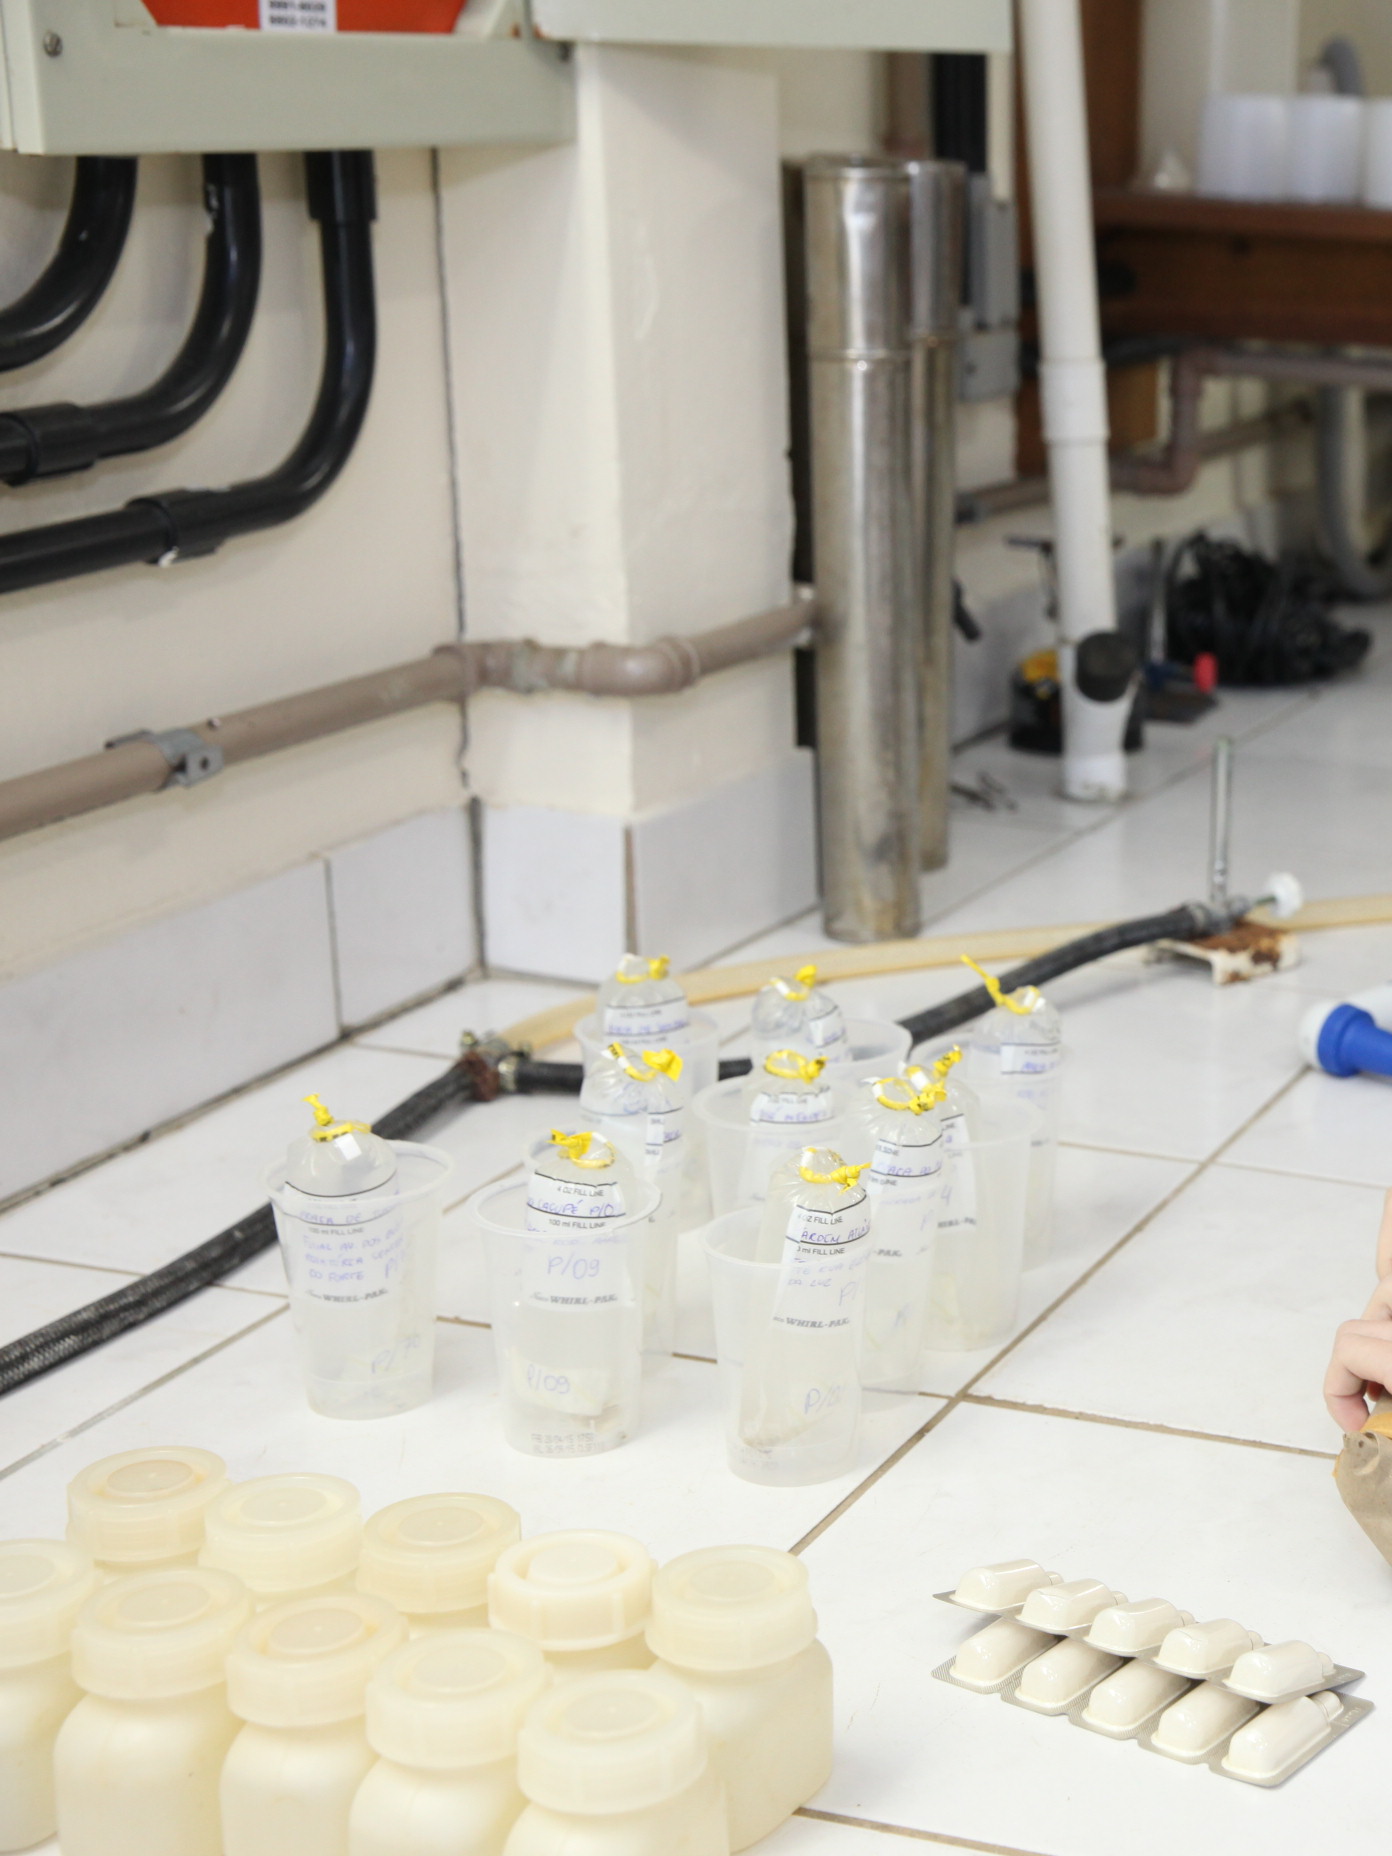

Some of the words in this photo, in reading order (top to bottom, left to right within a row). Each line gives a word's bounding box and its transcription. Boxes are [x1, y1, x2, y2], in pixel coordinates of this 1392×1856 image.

[574, 1188, 588, 1197] FILL
[572, 1221, 588, 1229] FILL
[814, 1216, 829, 1225] FILL
[830, 1216, 844, 1226] LINE
[812, 1248, 828, 1256] FILL
[829, 1247, 846, 1256] LINE
[547, 1251, 601, 1280] P/09
